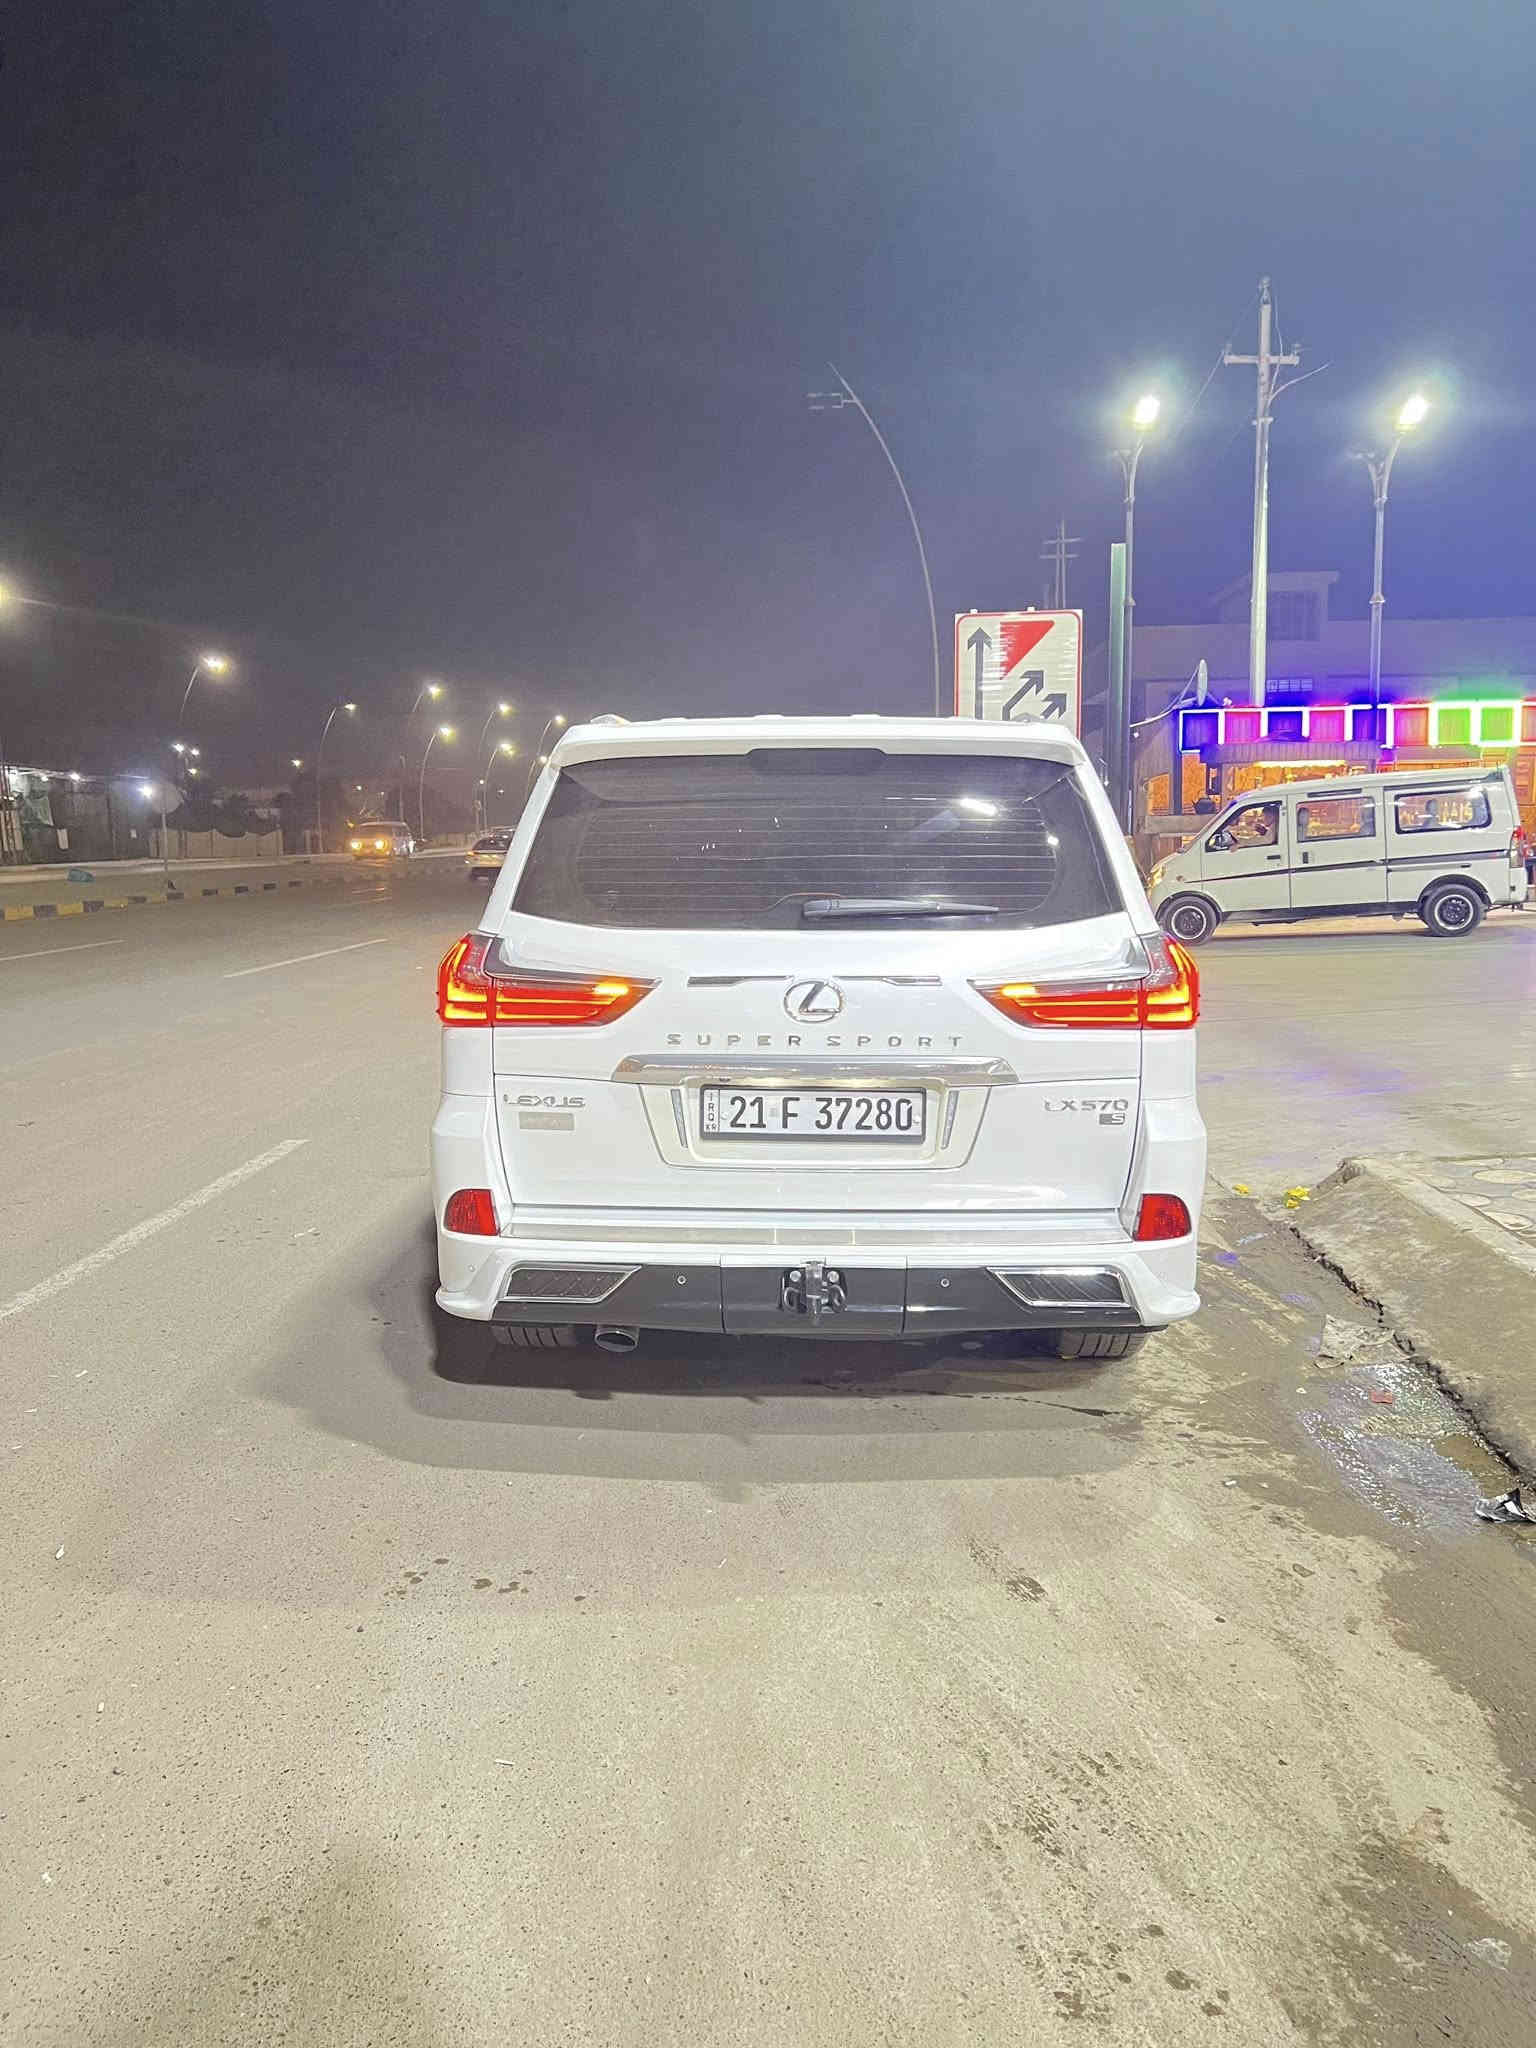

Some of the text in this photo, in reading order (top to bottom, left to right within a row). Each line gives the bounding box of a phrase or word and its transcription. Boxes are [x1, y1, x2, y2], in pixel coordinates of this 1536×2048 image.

[667, 1034, 964, 1048] SUPER SPORT
[503, 1093, 586, 1108] LEXUS
[730, 1096, 913, 1130] 21 F 37280
